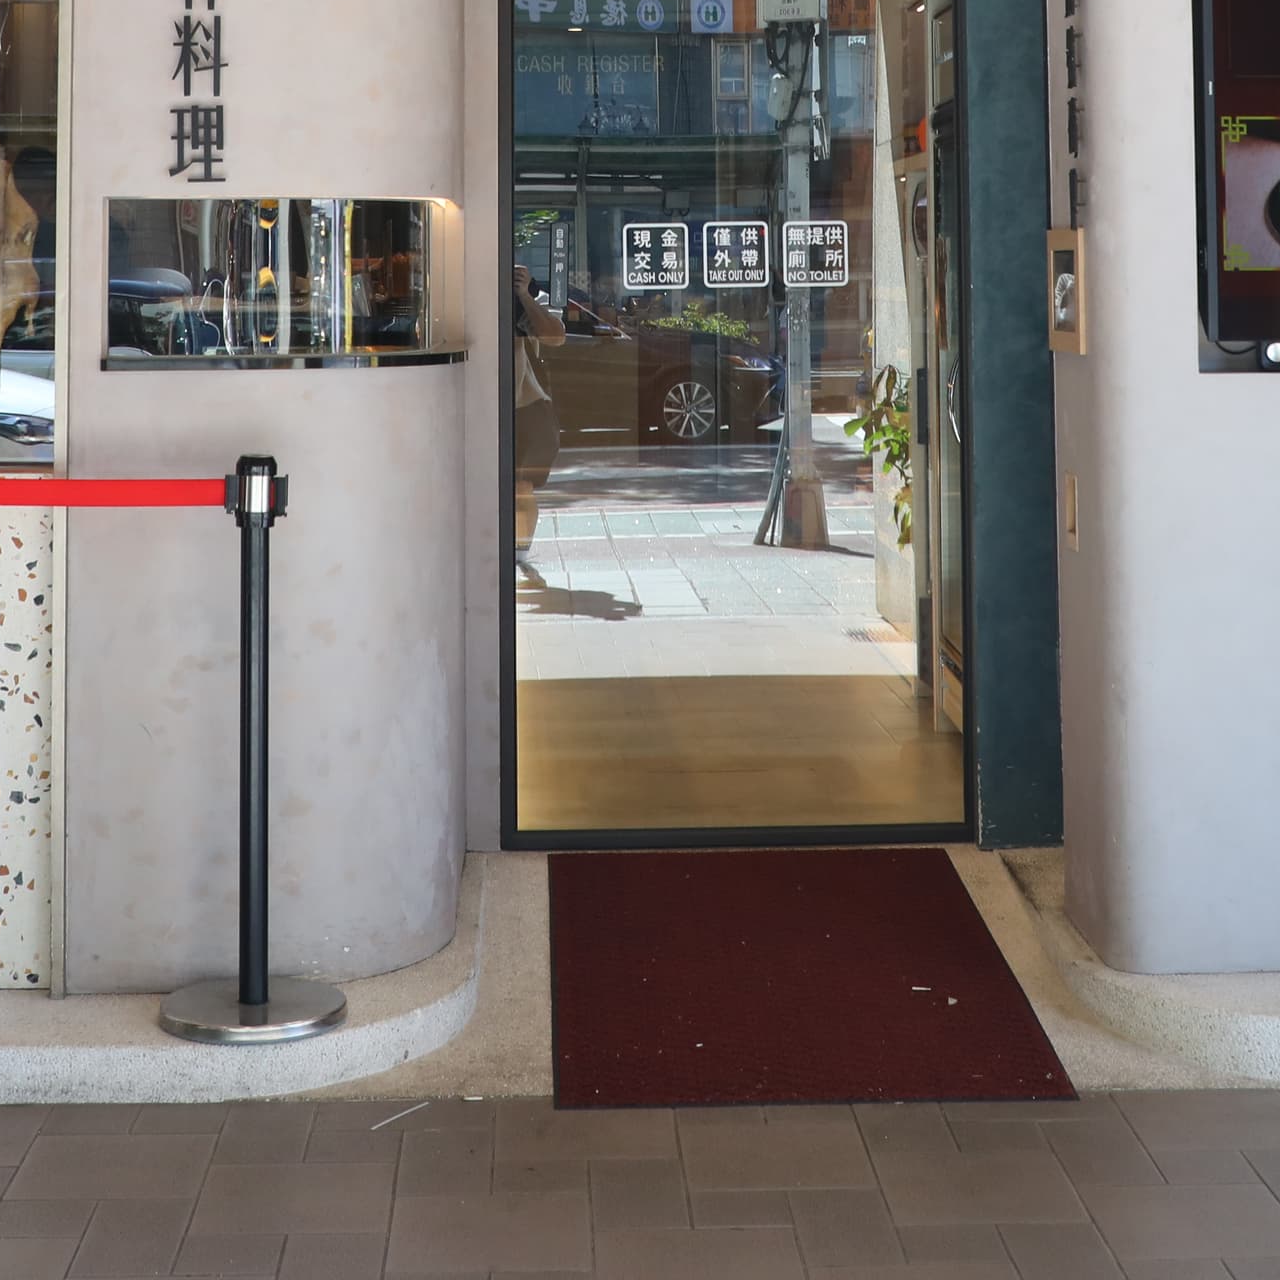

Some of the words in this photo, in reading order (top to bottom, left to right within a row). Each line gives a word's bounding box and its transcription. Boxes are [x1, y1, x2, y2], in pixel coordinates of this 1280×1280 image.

[517, 55, 564, 72] CASH
[577, 55, 665, 73] REGISTER
[633, 229, 678, 248] 現金
[713, 227, 759, 246] 僅供
[787, 226, 843, 245] 無提供
[634, 252, 678, 270] 交易
[713, 249, 759, 268] 外帶
[788, 250, 843, 268] 廁所
[628, 272, 656, 283] CASH
[658, 271, 684, 283] ONLY
[709, 270, 727, 281] TAKE
[728, 270, 743, 281] OUT
[745, 269, 765, 281] ONLY
[788, 271, 807, 281] NO
[809, 270, 844, 280] TOILET
